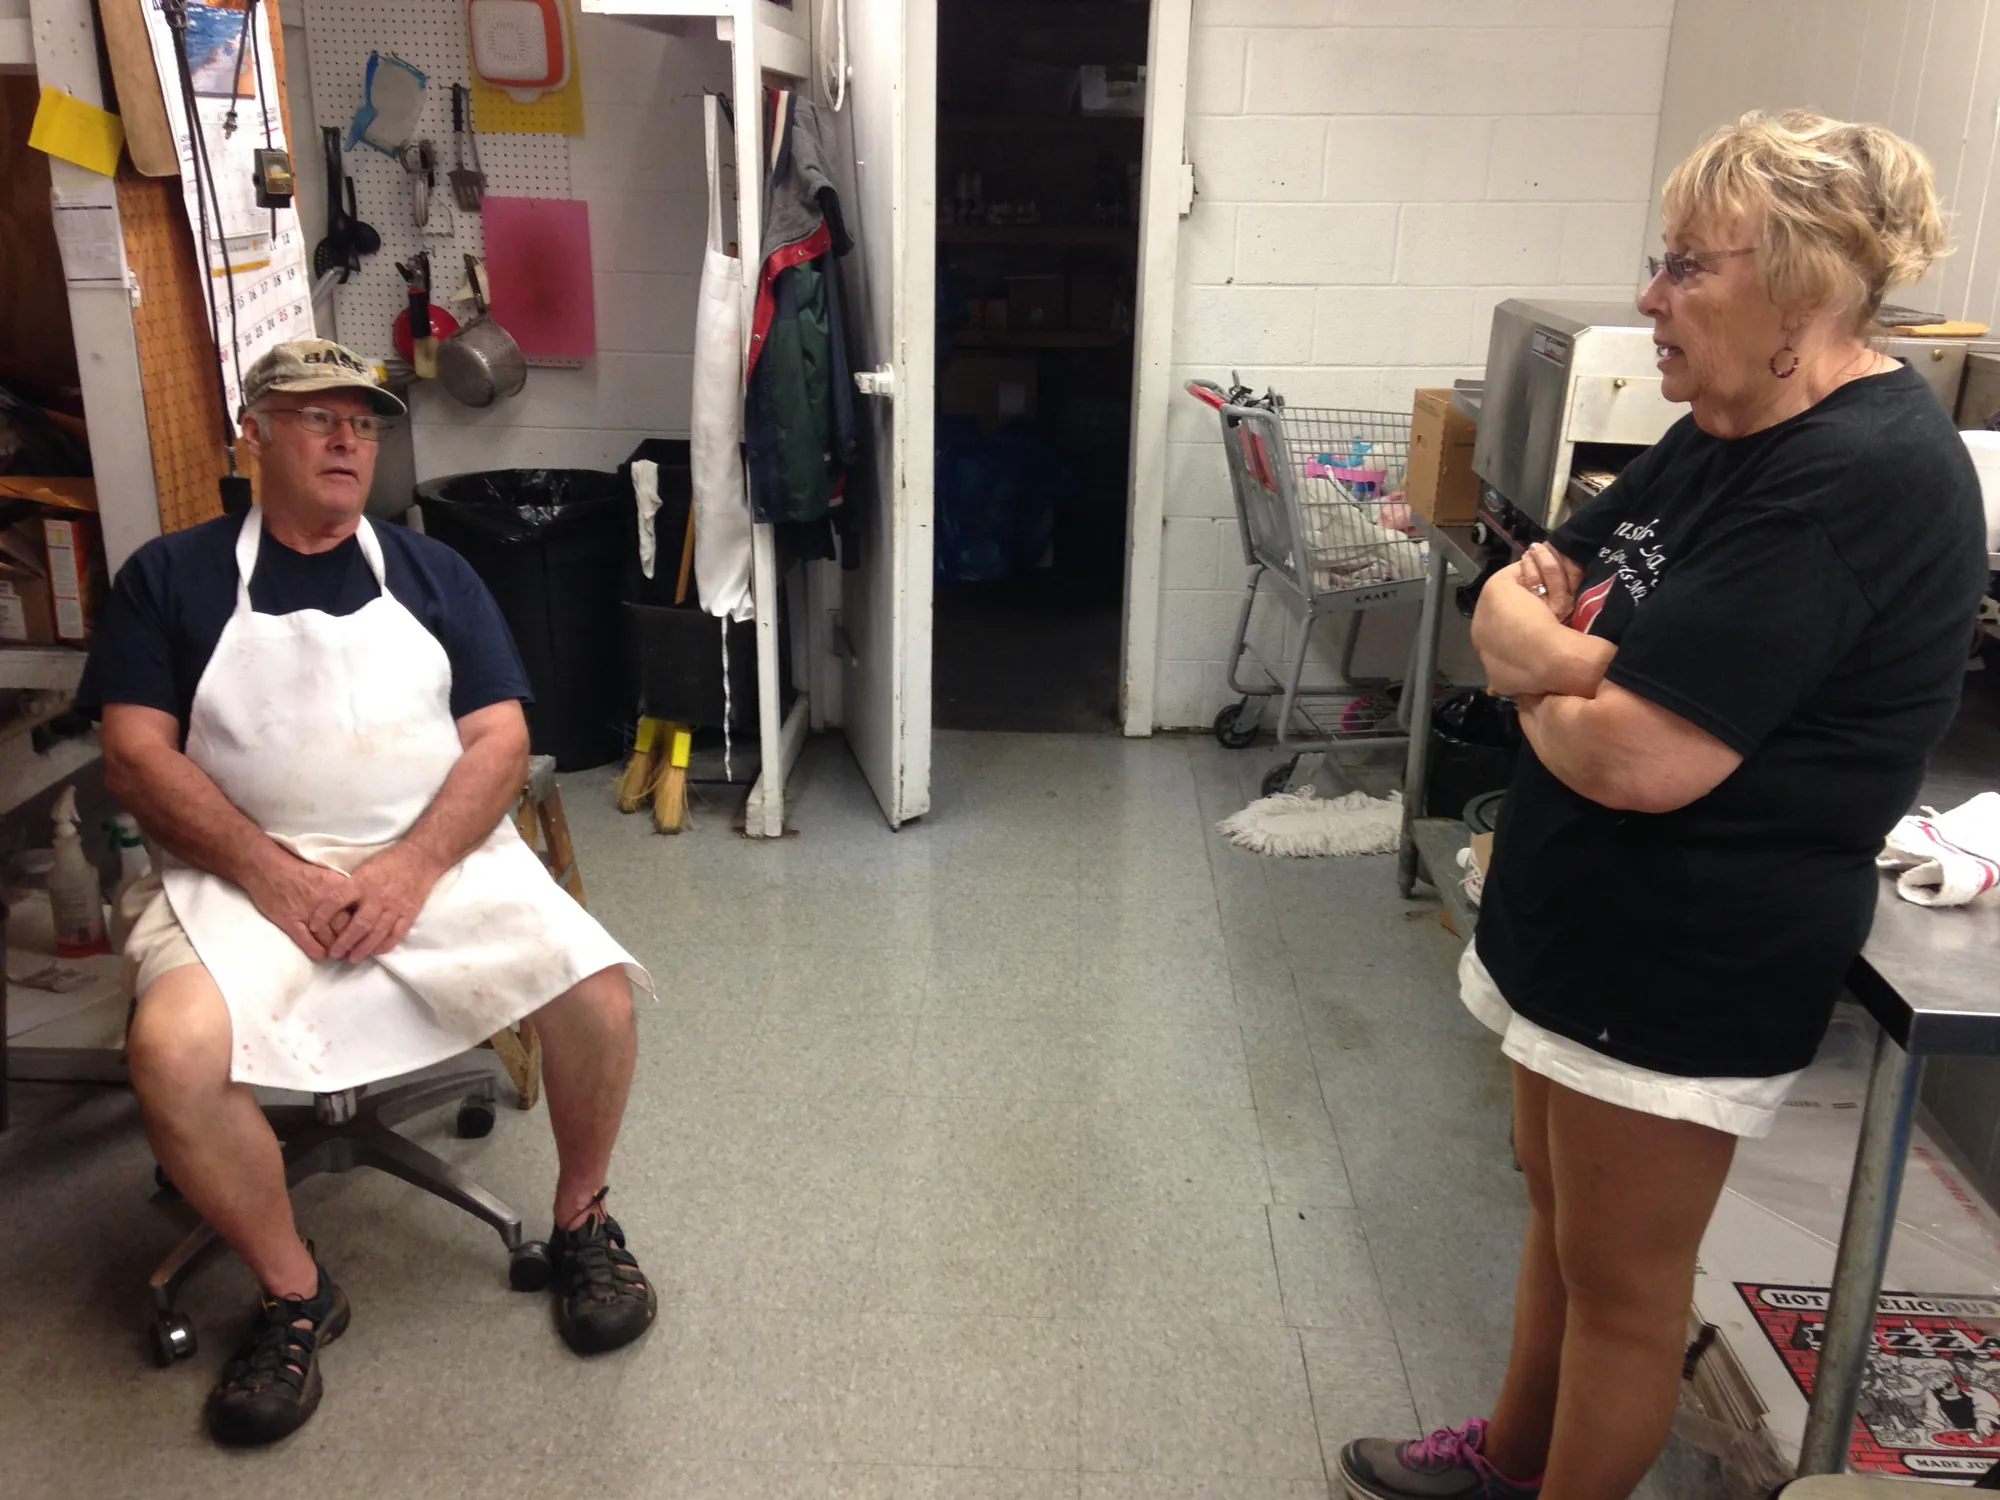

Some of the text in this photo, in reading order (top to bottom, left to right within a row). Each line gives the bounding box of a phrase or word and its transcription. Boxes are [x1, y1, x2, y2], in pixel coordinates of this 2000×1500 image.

[1770, 1292, 1996, 1315] HOT ELICIOUS
[1915, 1459, 1964, 1469] MADE
